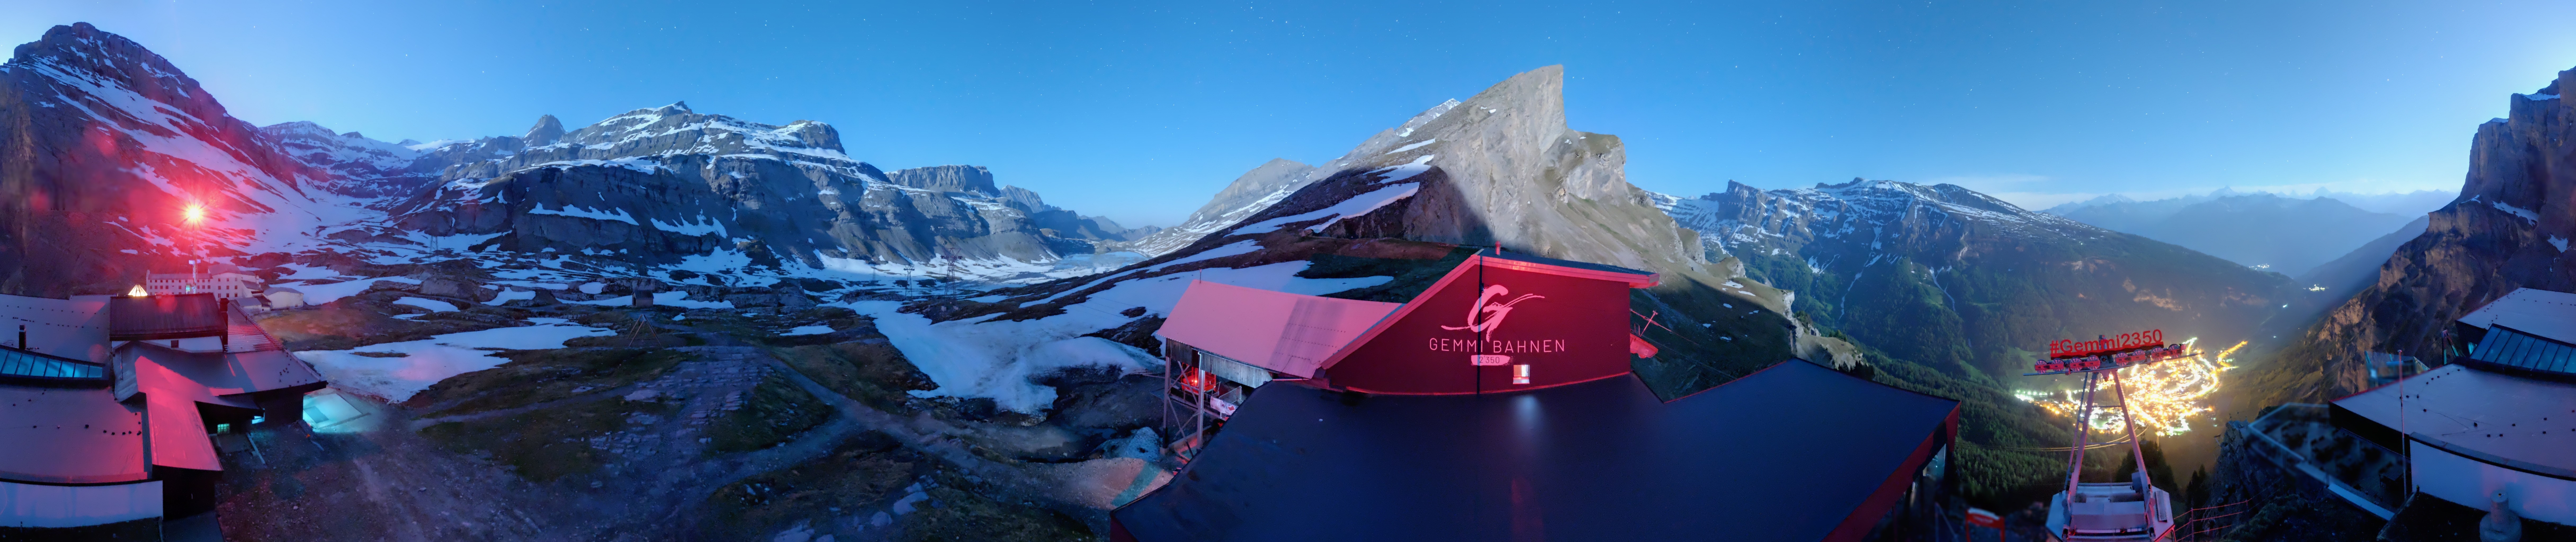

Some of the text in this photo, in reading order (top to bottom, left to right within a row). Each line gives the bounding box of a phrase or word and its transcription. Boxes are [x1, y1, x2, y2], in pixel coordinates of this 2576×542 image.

[1430, 338, 1564, 353] GEMMI BAHNEN
[2050, 329, 2162, 353] #Gemmi2350
[1479, 355, 1500, 364] 2'350
